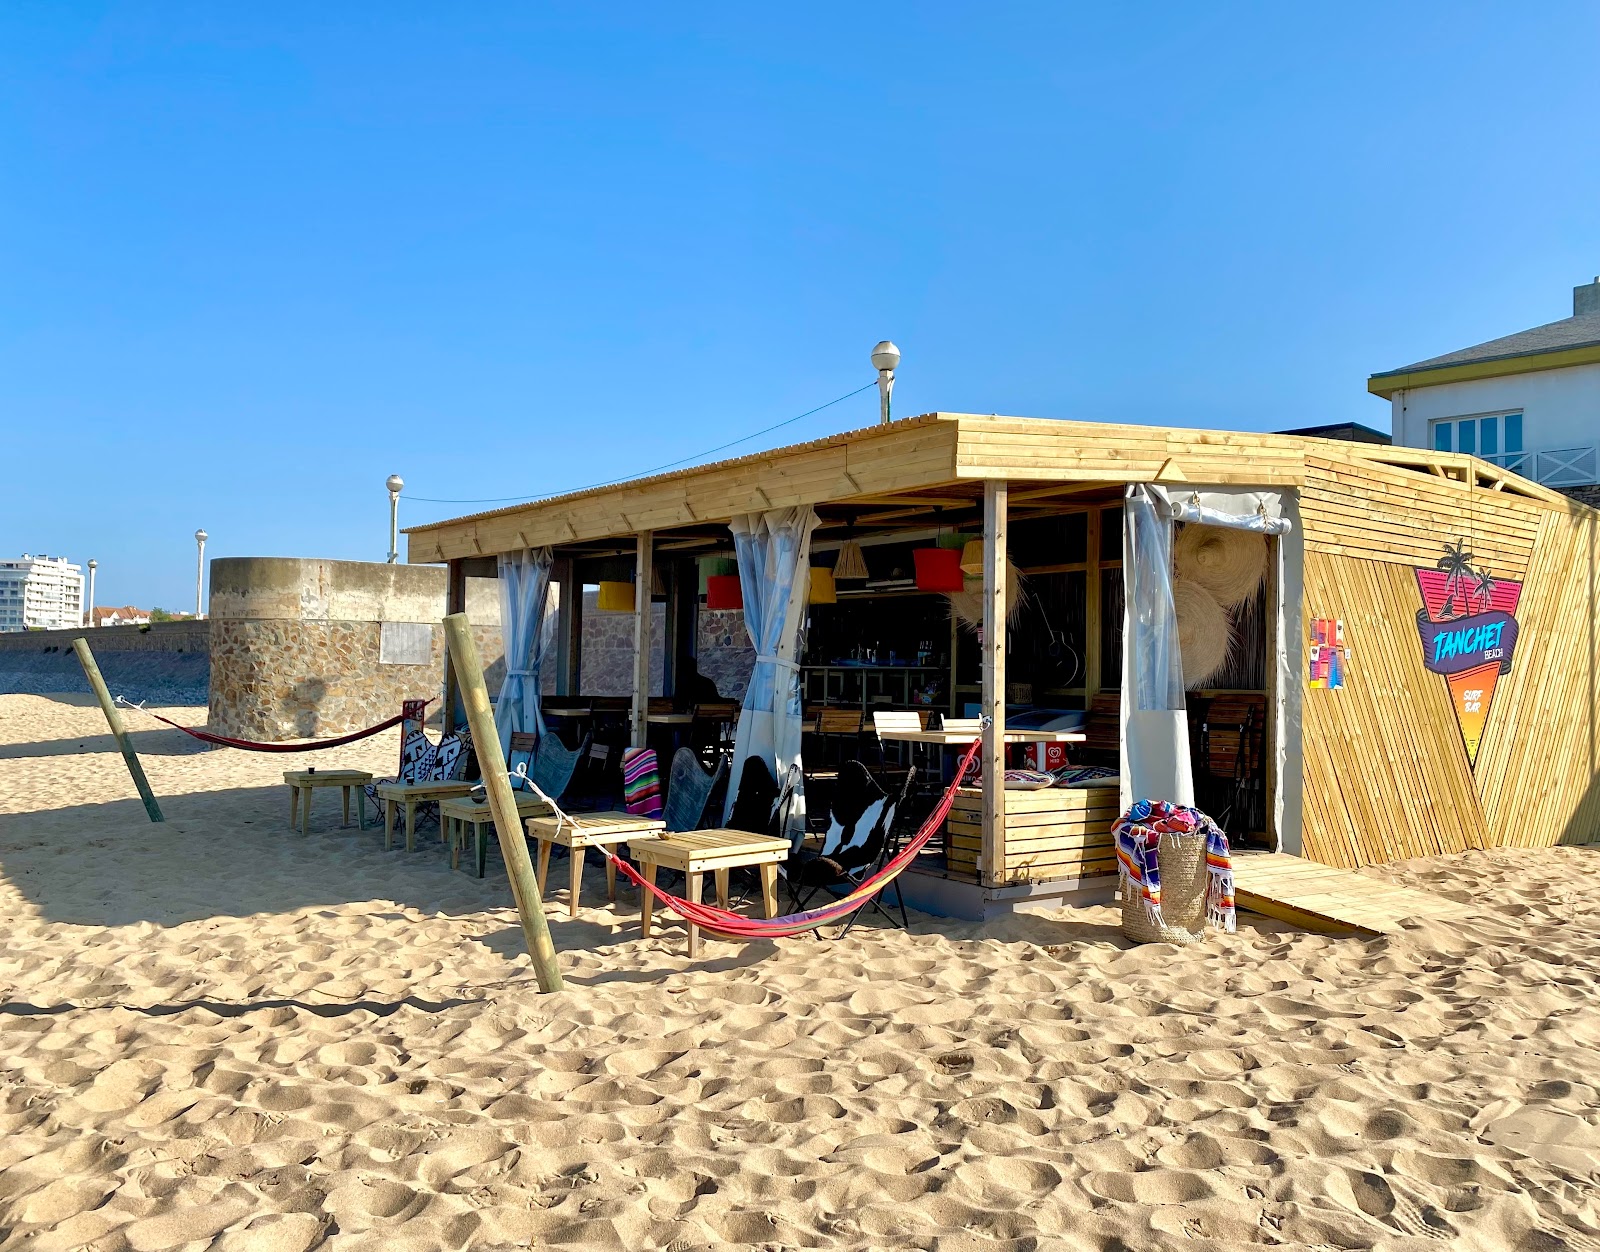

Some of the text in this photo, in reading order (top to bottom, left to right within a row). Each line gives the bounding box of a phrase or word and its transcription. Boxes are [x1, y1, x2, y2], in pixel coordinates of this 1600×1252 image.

[1433, 621, 1506, 665] TANCHET
[1484, 648, 1503, 660] BEACH
[1464, 690, 1483, 701] SURF
[1465, 702, 1481, 713] BAR
